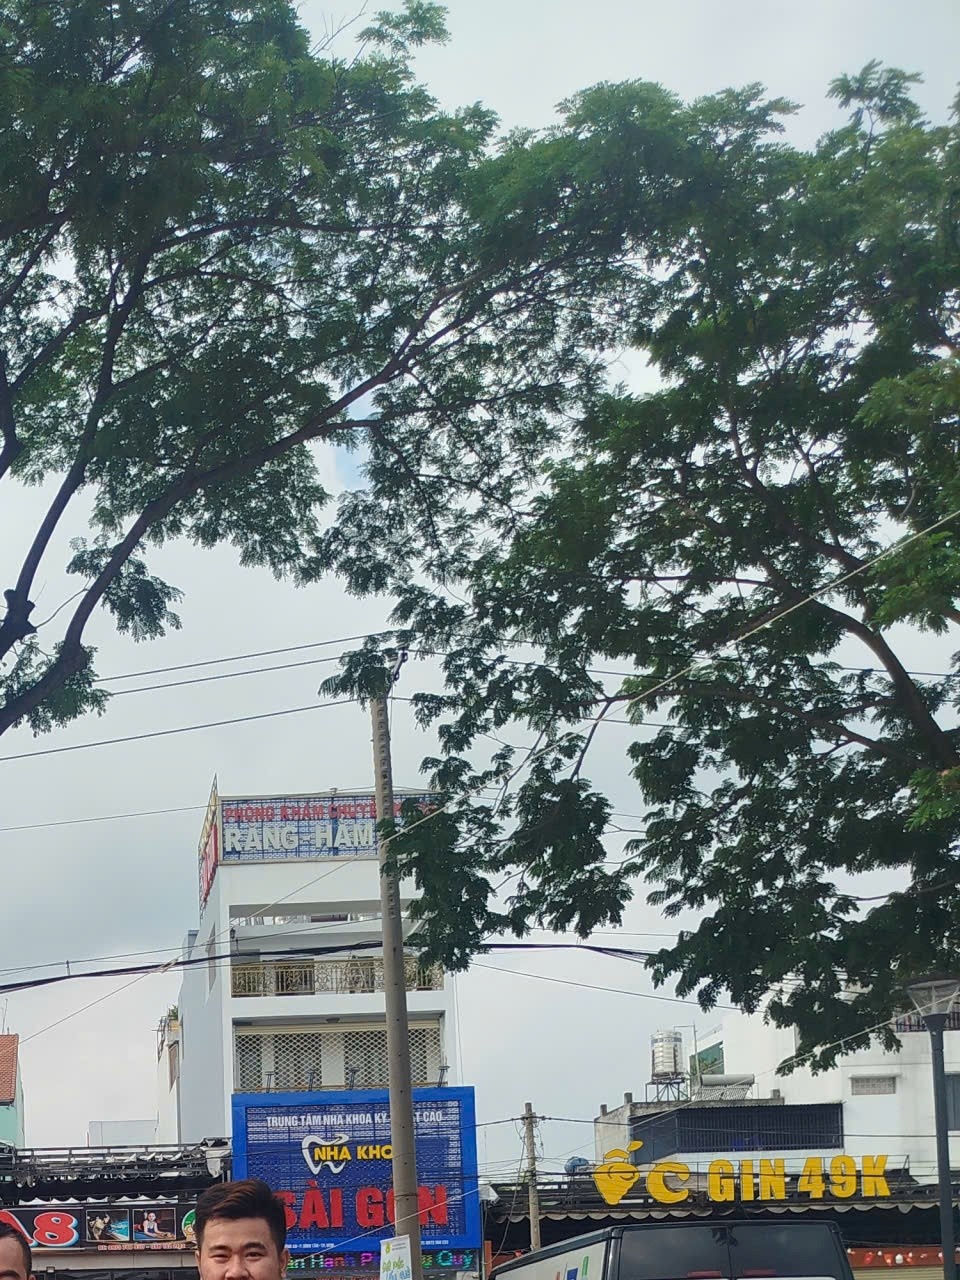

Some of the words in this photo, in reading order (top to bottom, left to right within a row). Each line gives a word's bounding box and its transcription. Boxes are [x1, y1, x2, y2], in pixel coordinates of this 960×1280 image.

[224, 821, 299, 852] RĂNG
[315, 819, 374, 849] HÀM
[266, 1116, 298, 1128] TRUNG
[300, 1113, 321, 1127] TÂM
[323, 1114, 343, 1125] NHA
[345, 1113, 373, 1125] KHOA
[423, 1111, 443, 1123] CAO
[313, 1145, 352, 1162] NHA
[357, 1144, 393, 1161] KHO
[707, 1156, 787, 1203] GIN
[797, 1155, 891, 1199] 49K
[273, 1180, 343, 1231] SÀI
[354, 1184, 449, 1231] GN
